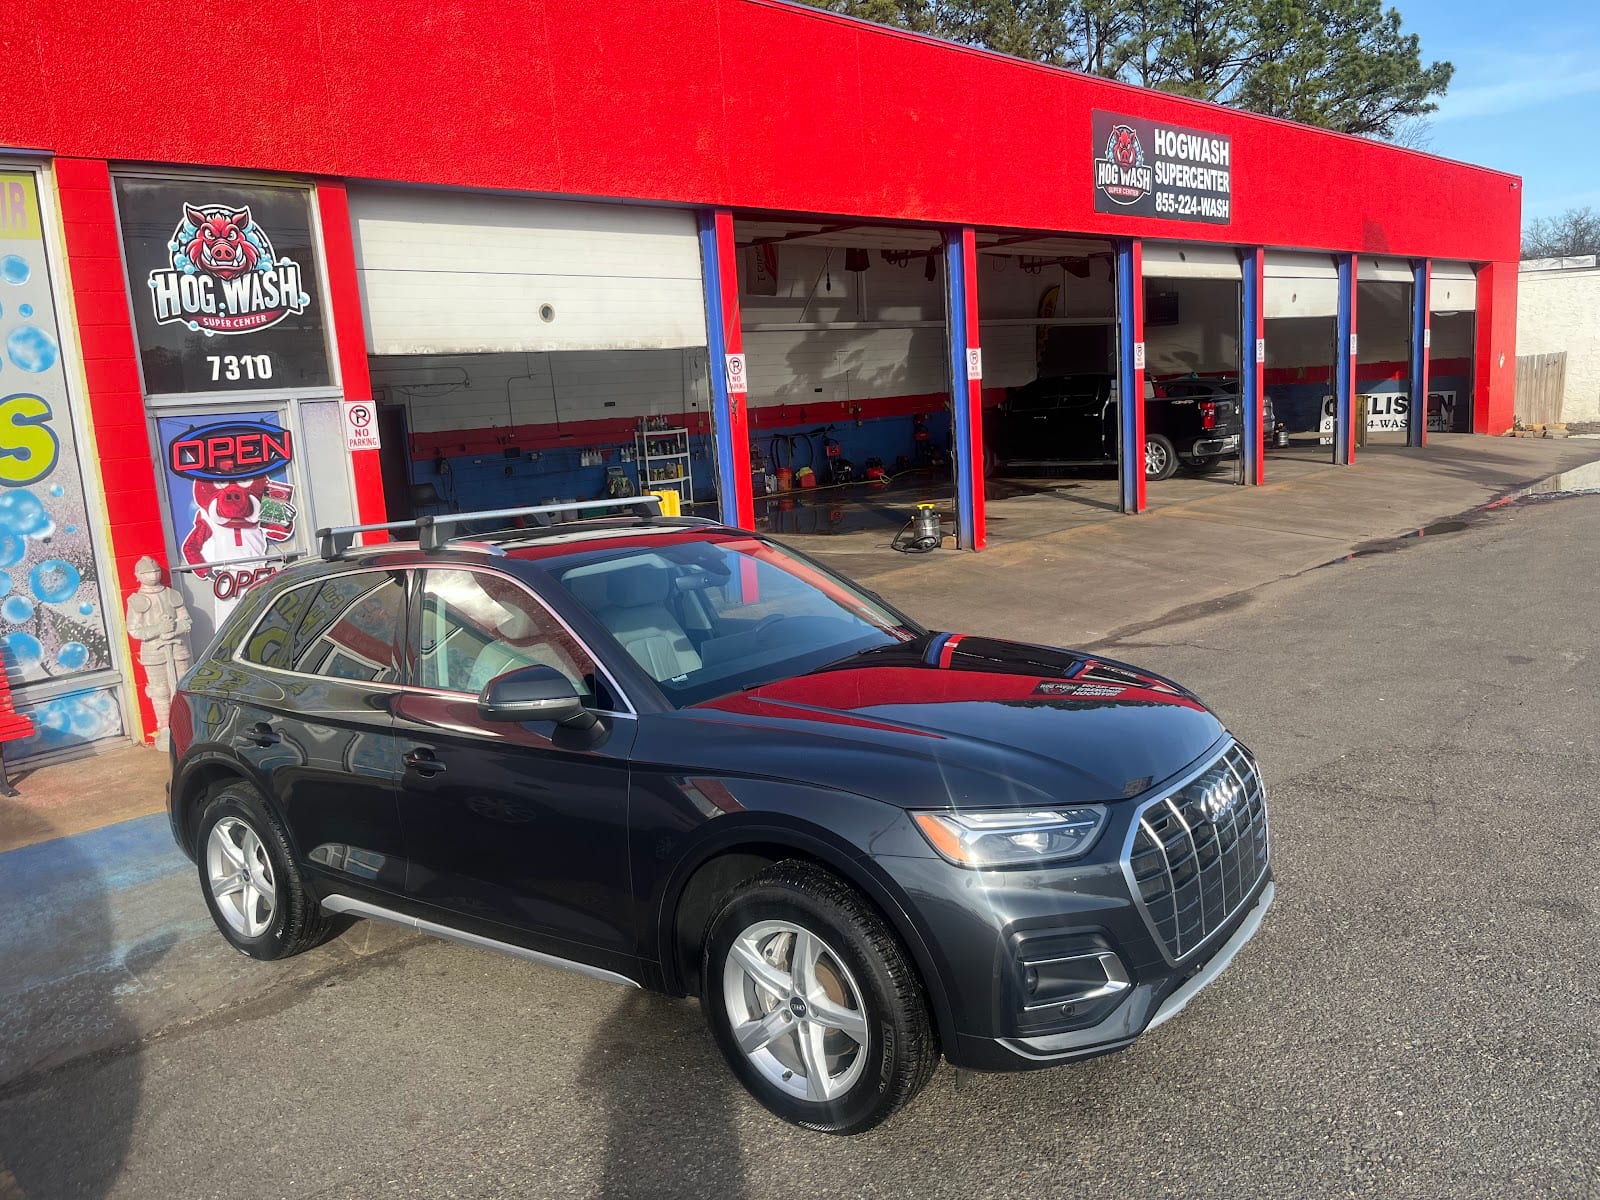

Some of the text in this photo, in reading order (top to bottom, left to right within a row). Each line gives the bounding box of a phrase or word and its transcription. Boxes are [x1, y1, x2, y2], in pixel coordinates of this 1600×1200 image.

[1154, 128, 1230, 166] HOGWASH
[1098, 163, 1150, 191] HOG WASH
[1155, 160, 1230, 193] SUPERCENTER
[1155, 191, 1229, 218] 855-224-WASH
[155, 266, 299, 319] HOG WASH
[203, 315, 267, 328] SUPER CENTER
[206, 354, 273, 381] 7310
[349, 437, 377, 447] PARKING
[355, 428, 369, 437] NO
[173, 431, 291, 471] OPEN
